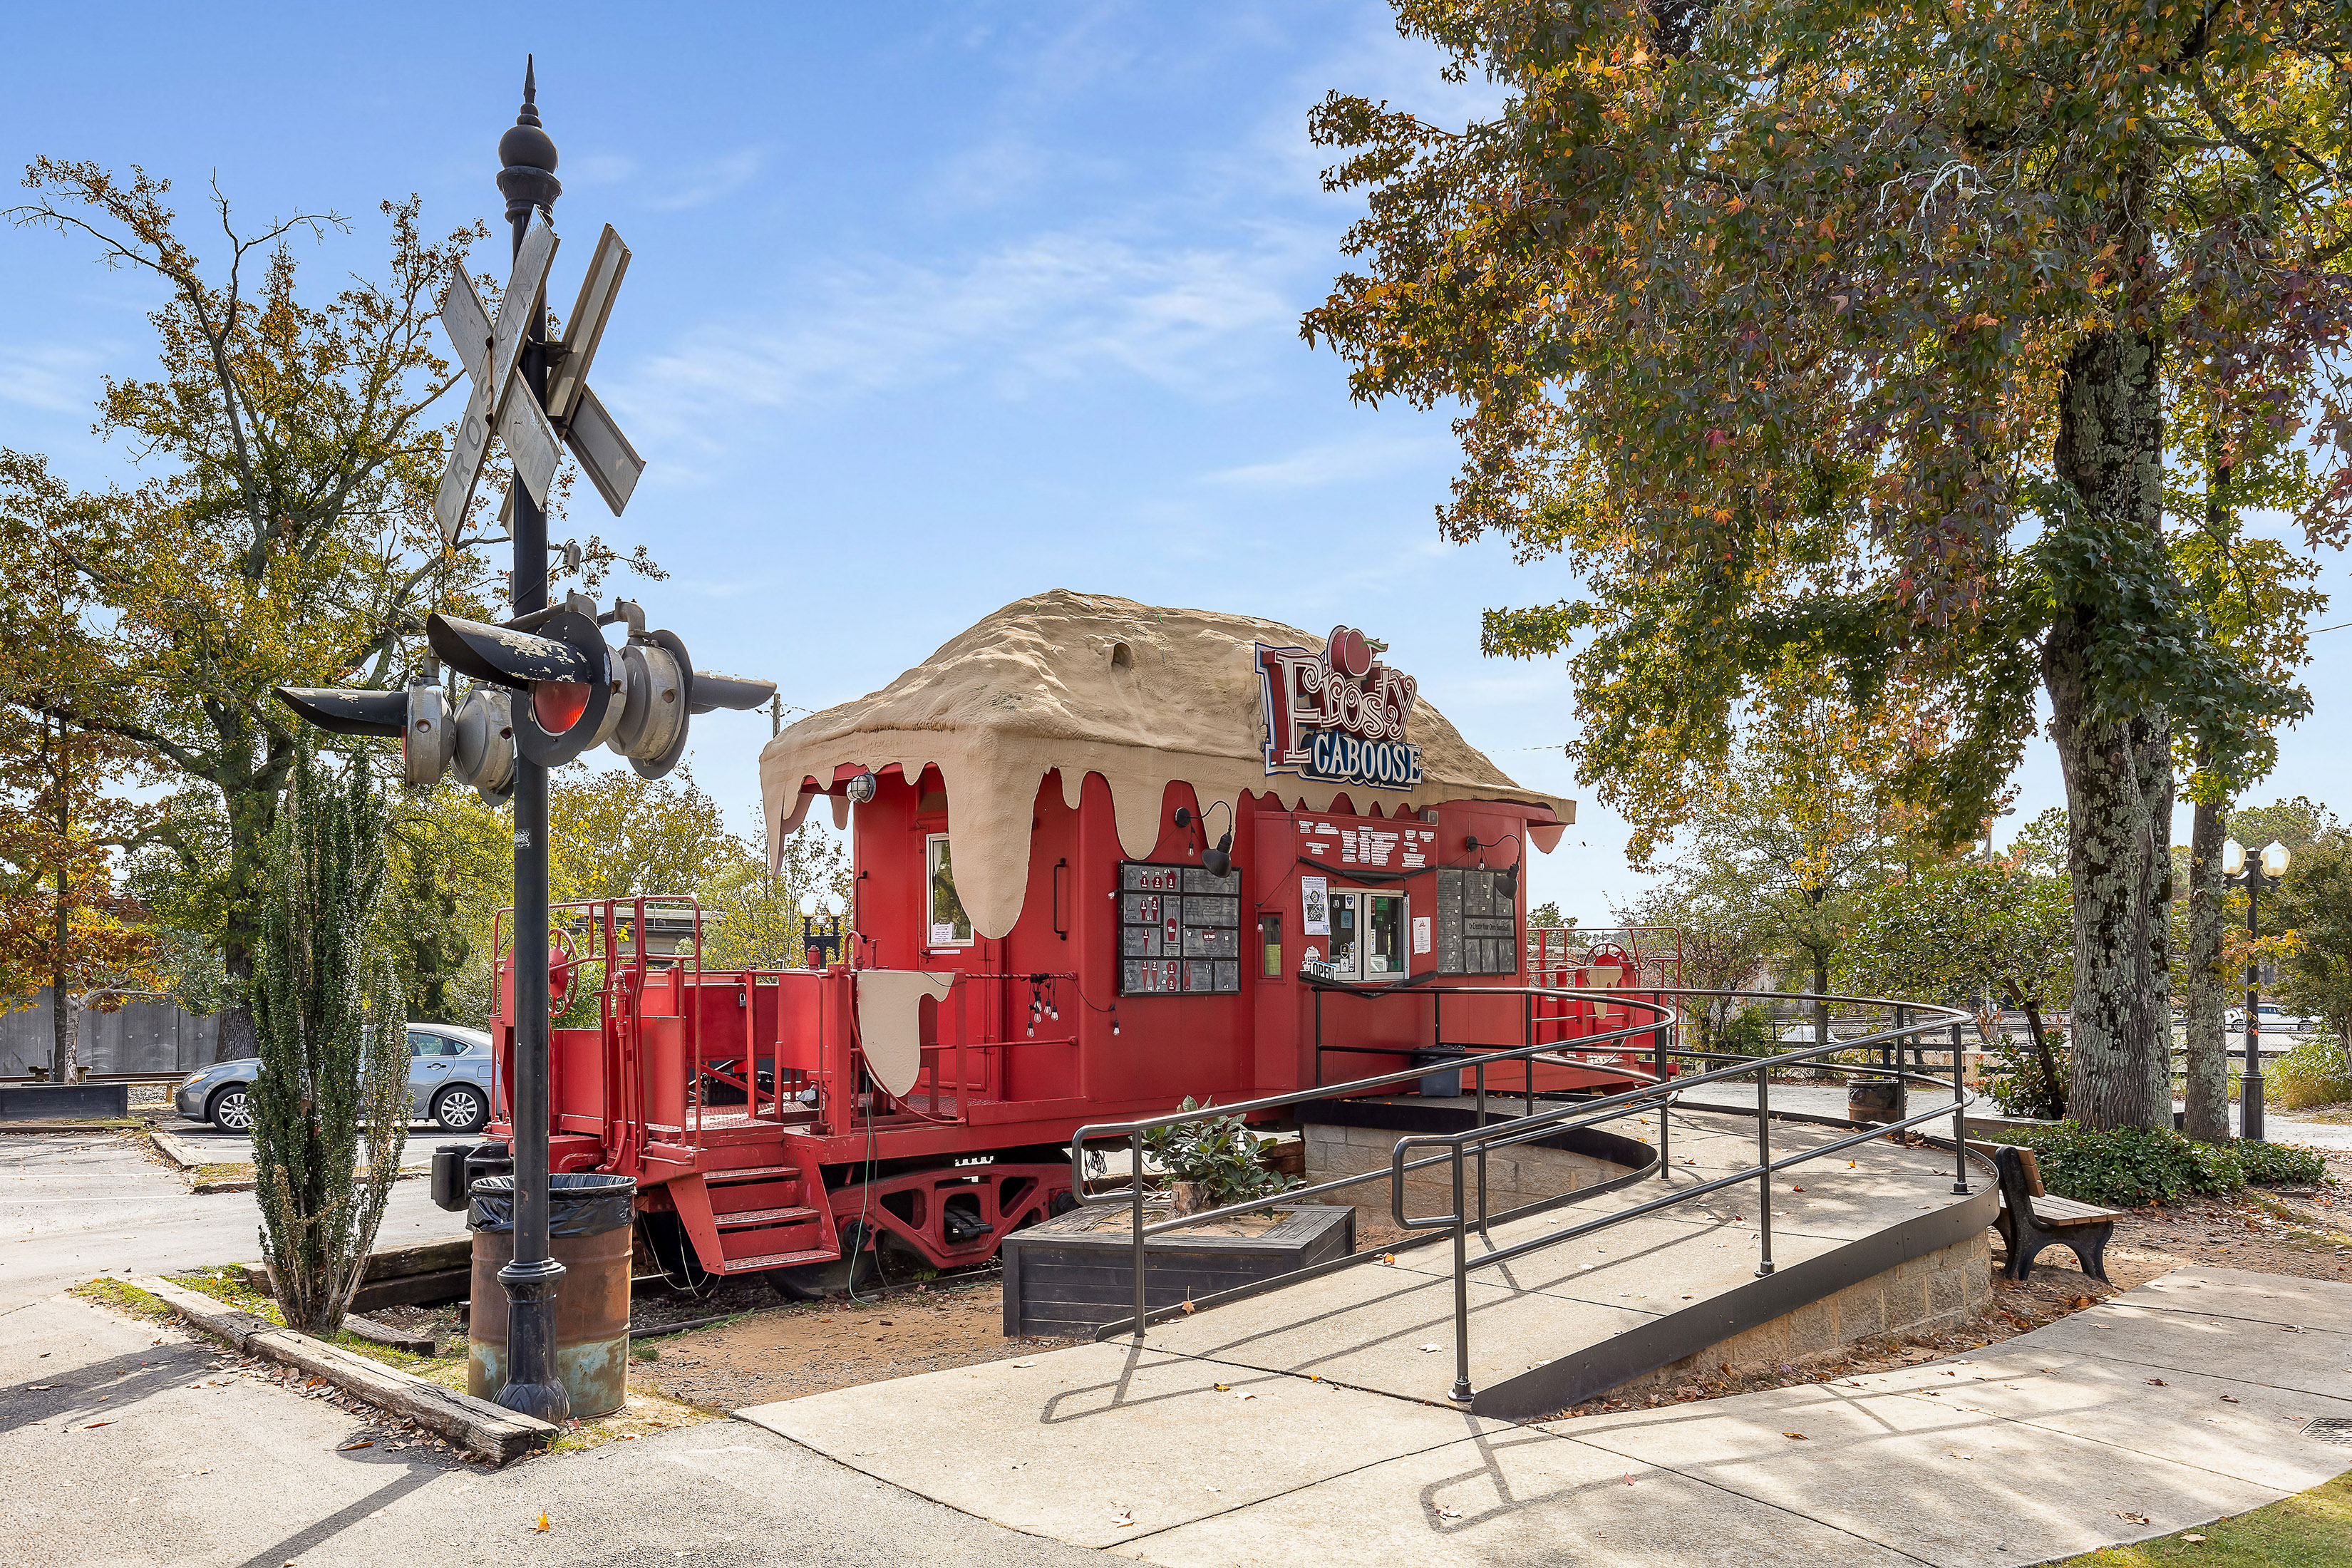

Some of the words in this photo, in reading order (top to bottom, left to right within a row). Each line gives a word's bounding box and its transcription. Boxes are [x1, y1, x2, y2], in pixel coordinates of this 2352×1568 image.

[440, 267, 533, 524] CROSSIN
[1273, 649, 1418, 765] Frosty
[1314, 730, 1423, 784] CABOOSE
[1313, 962, 1335, 980] OPEN
